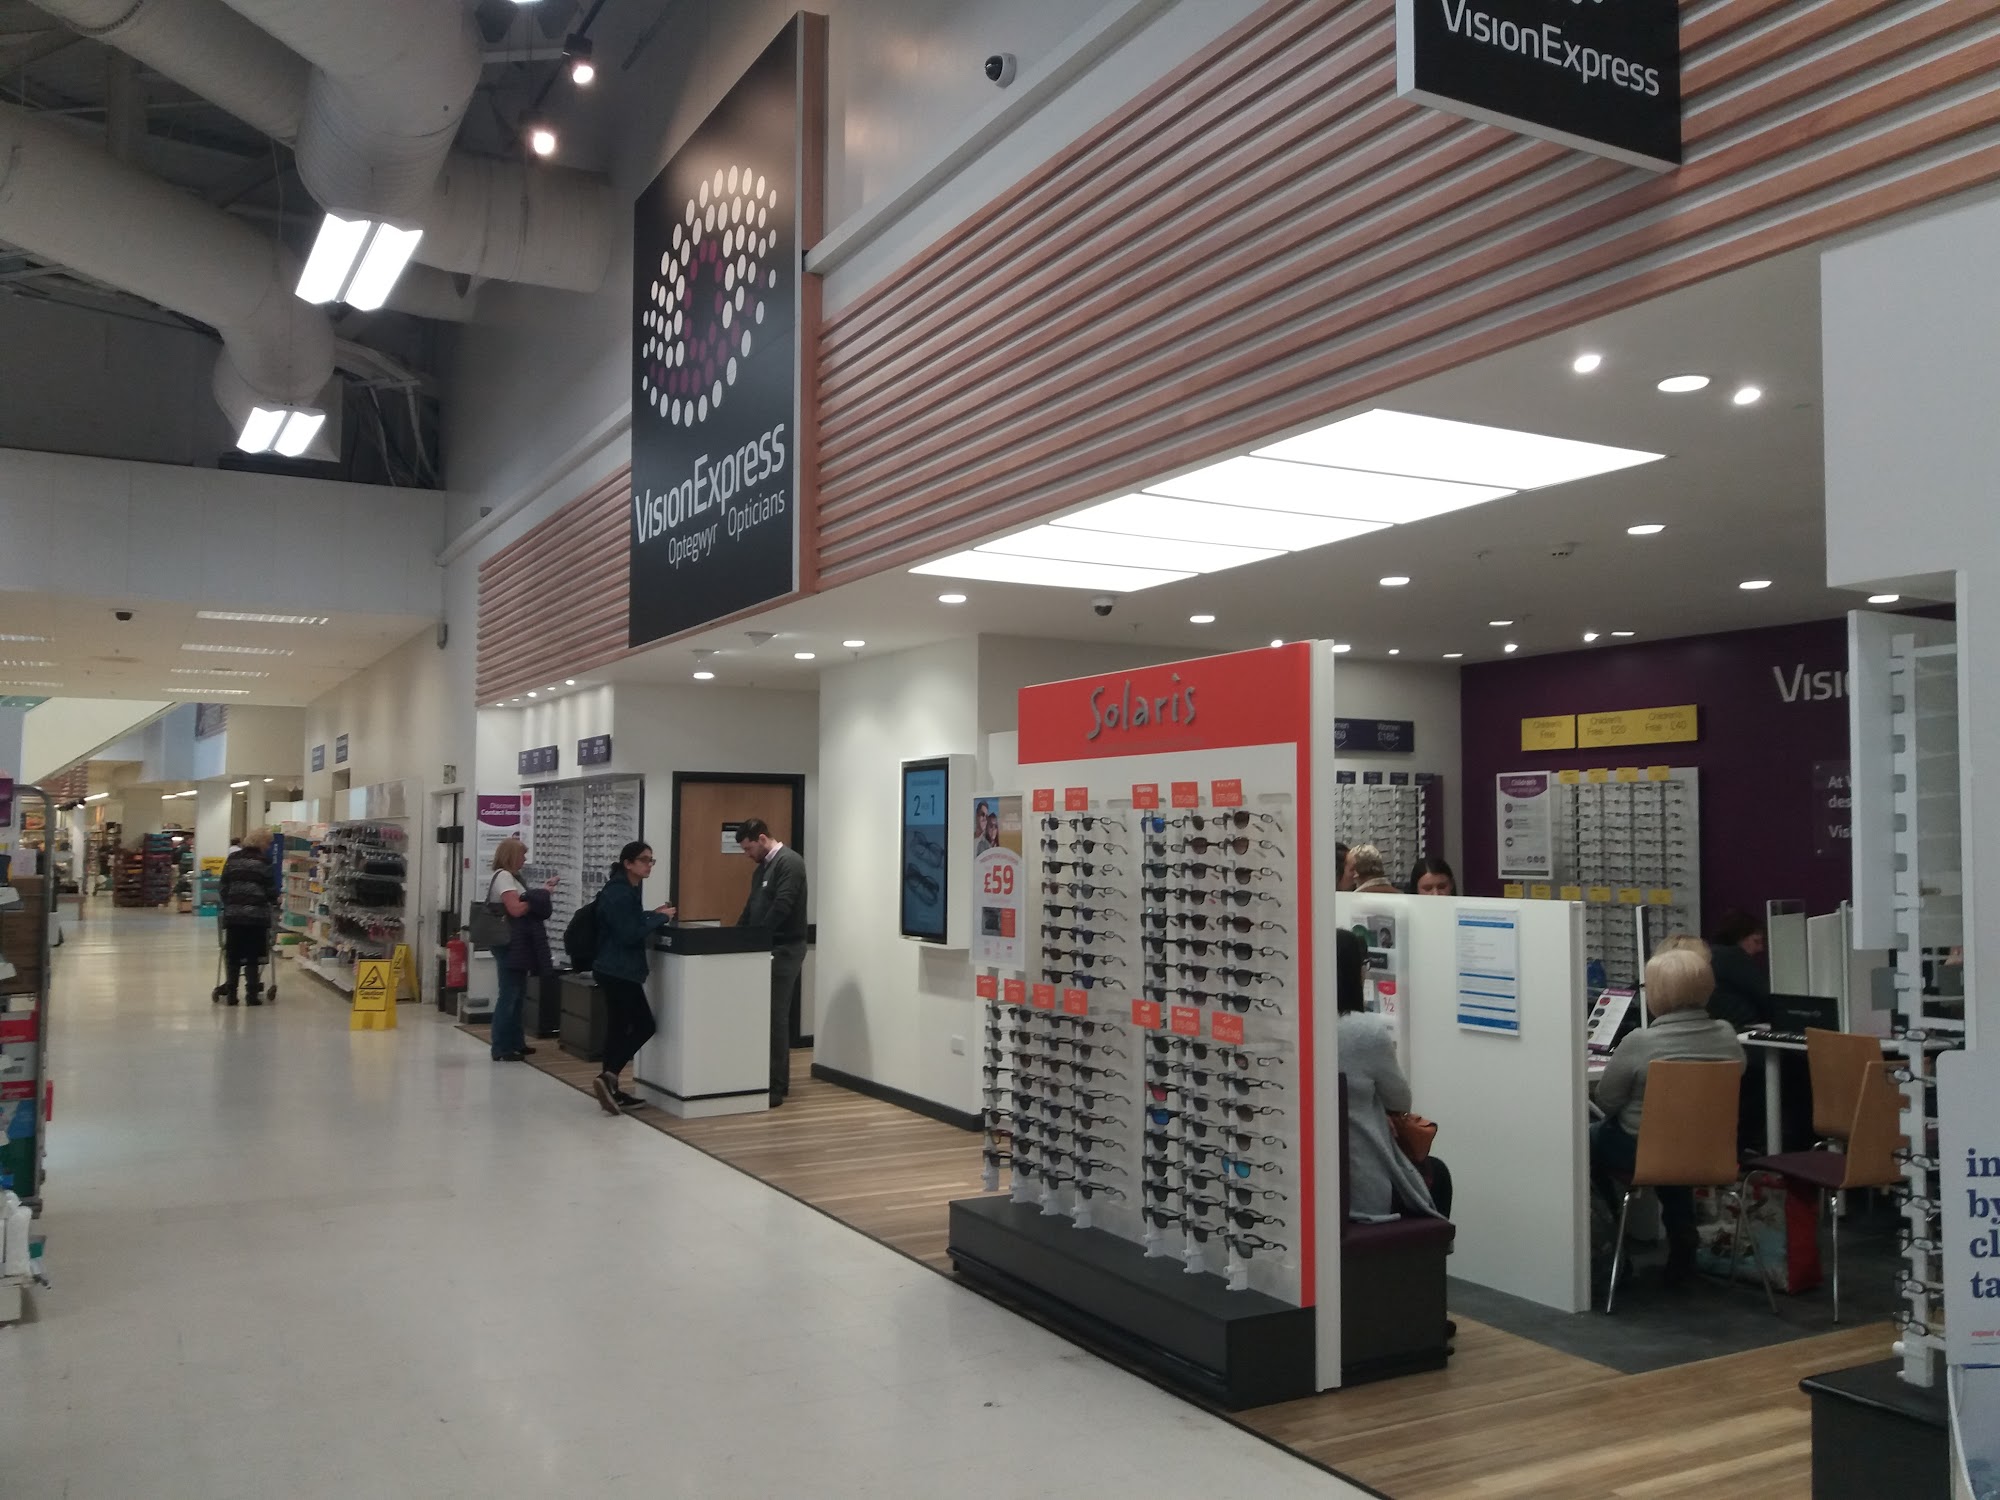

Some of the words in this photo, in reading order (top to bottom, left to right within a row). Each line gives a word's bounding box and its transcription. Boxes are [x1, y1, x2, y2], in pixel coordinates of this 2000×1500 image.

[1442, 0, 1660, 97] VisionExpress
[635, 423, 785, 544] VisionExpress
[668, 523, 718, 570] Optegwyr
[728, 489, 785, 543] Opticians
[1087, 672, 1196, 741] Solaris
[1773, 663, 1850, 703] Visi
[481, 808, 505, 816] Contact
[914, 795, 921, 816] 2
[931, 795, 935, 816] 1
[984, 864, 1014, 895] £59
